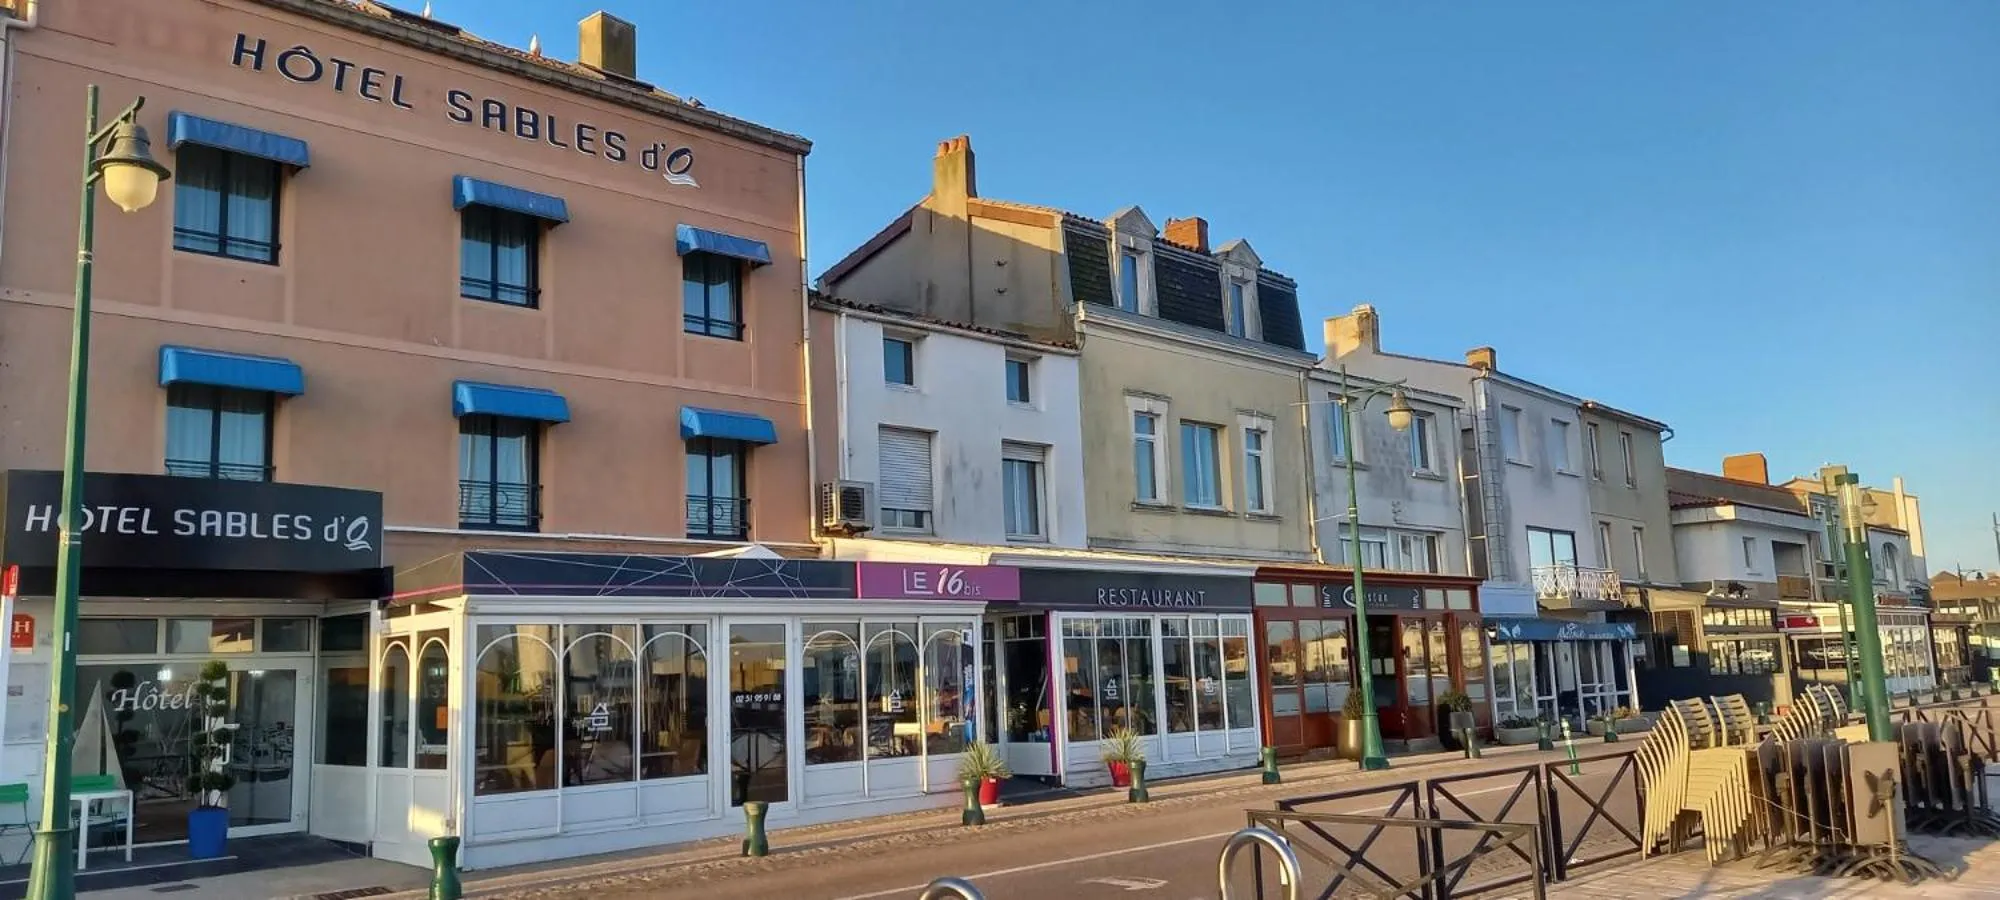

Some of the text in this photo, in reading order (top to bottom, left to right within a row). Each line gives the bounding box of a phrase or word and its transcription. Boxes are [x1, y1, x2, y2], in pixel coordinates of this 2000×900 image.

[231, 32, 413, 108] HÔTEL
[446, 89, 626, 162] SABLES
[173, 509, 312, 540] SABLES
[903, 568, 934, 595] LE
[1098, 587, 1206, 608] RESTAURANT
[14, 620, 31, 633] H
[111, 681, 201, 712] Hôtel
[735, 695, 745, 703] 02
